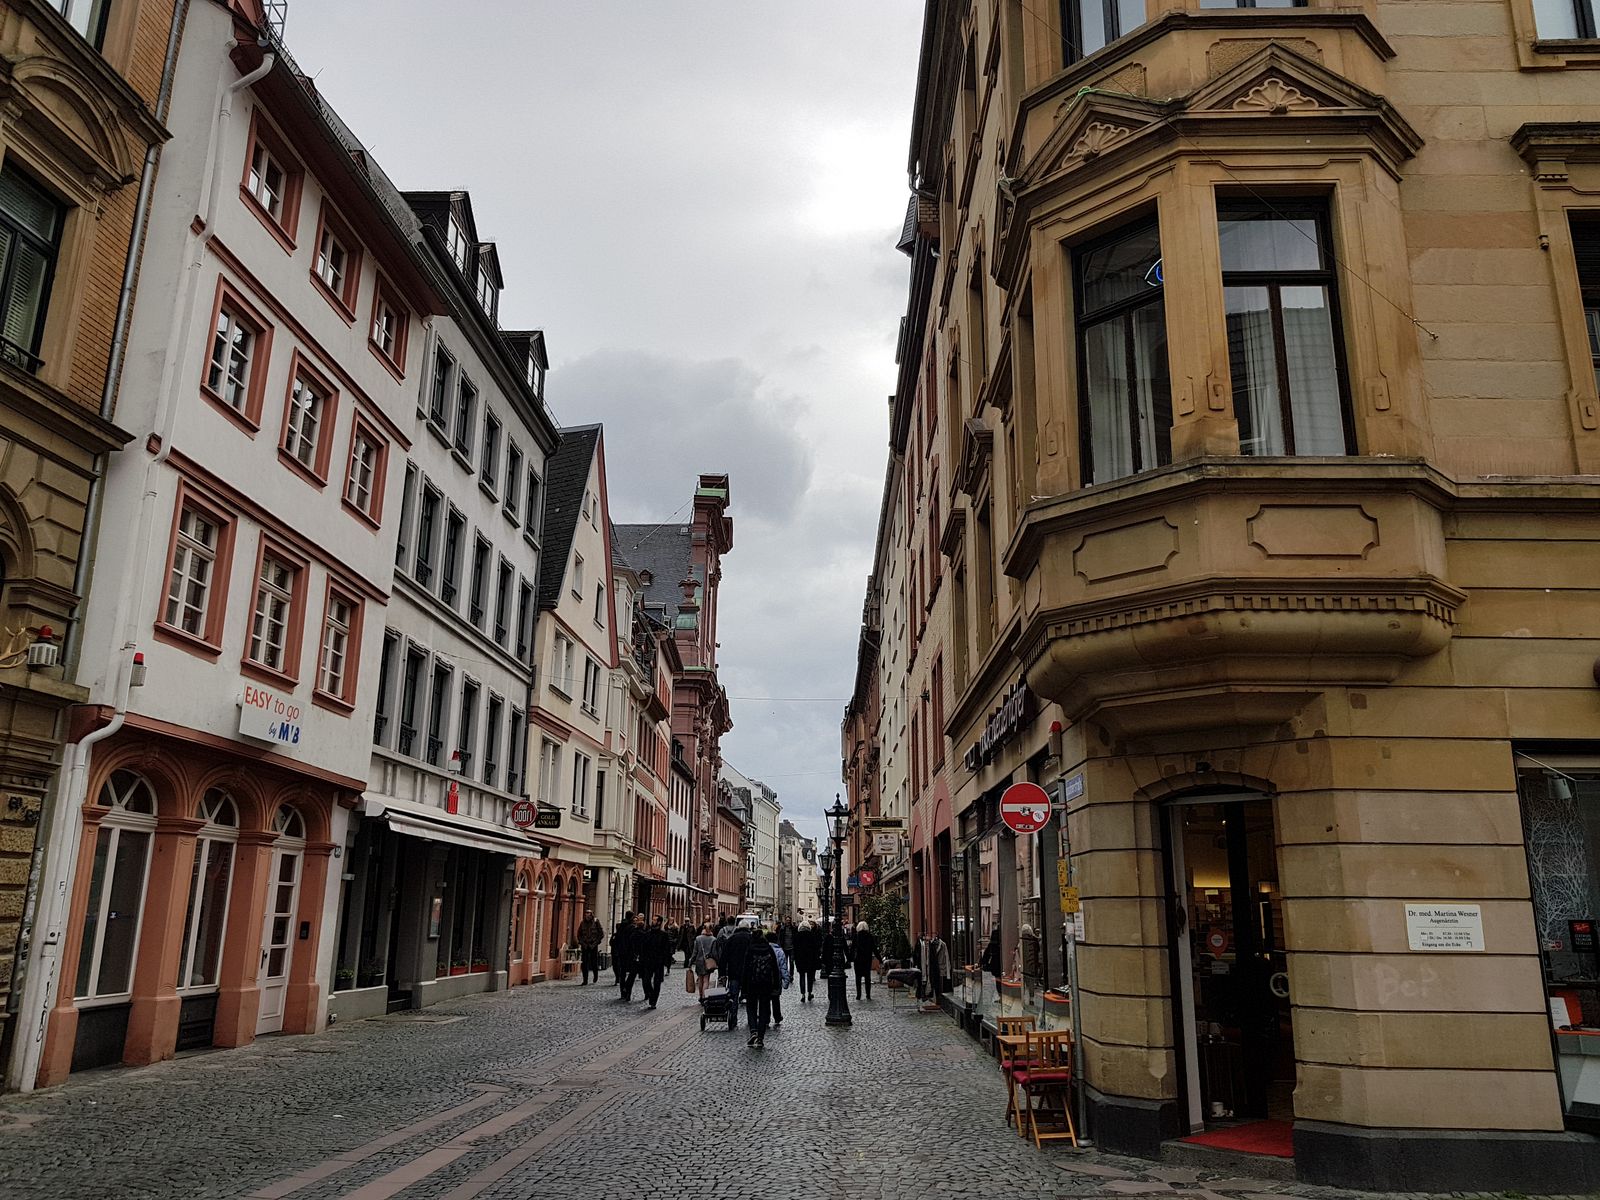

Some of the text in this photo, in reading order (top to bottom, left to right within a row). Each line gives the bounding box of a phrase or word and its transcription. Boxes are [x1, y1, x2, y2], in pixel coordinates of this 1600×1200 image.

[245, 686, 300, 723] EASY to go
[268, 721, 278, 738] by
